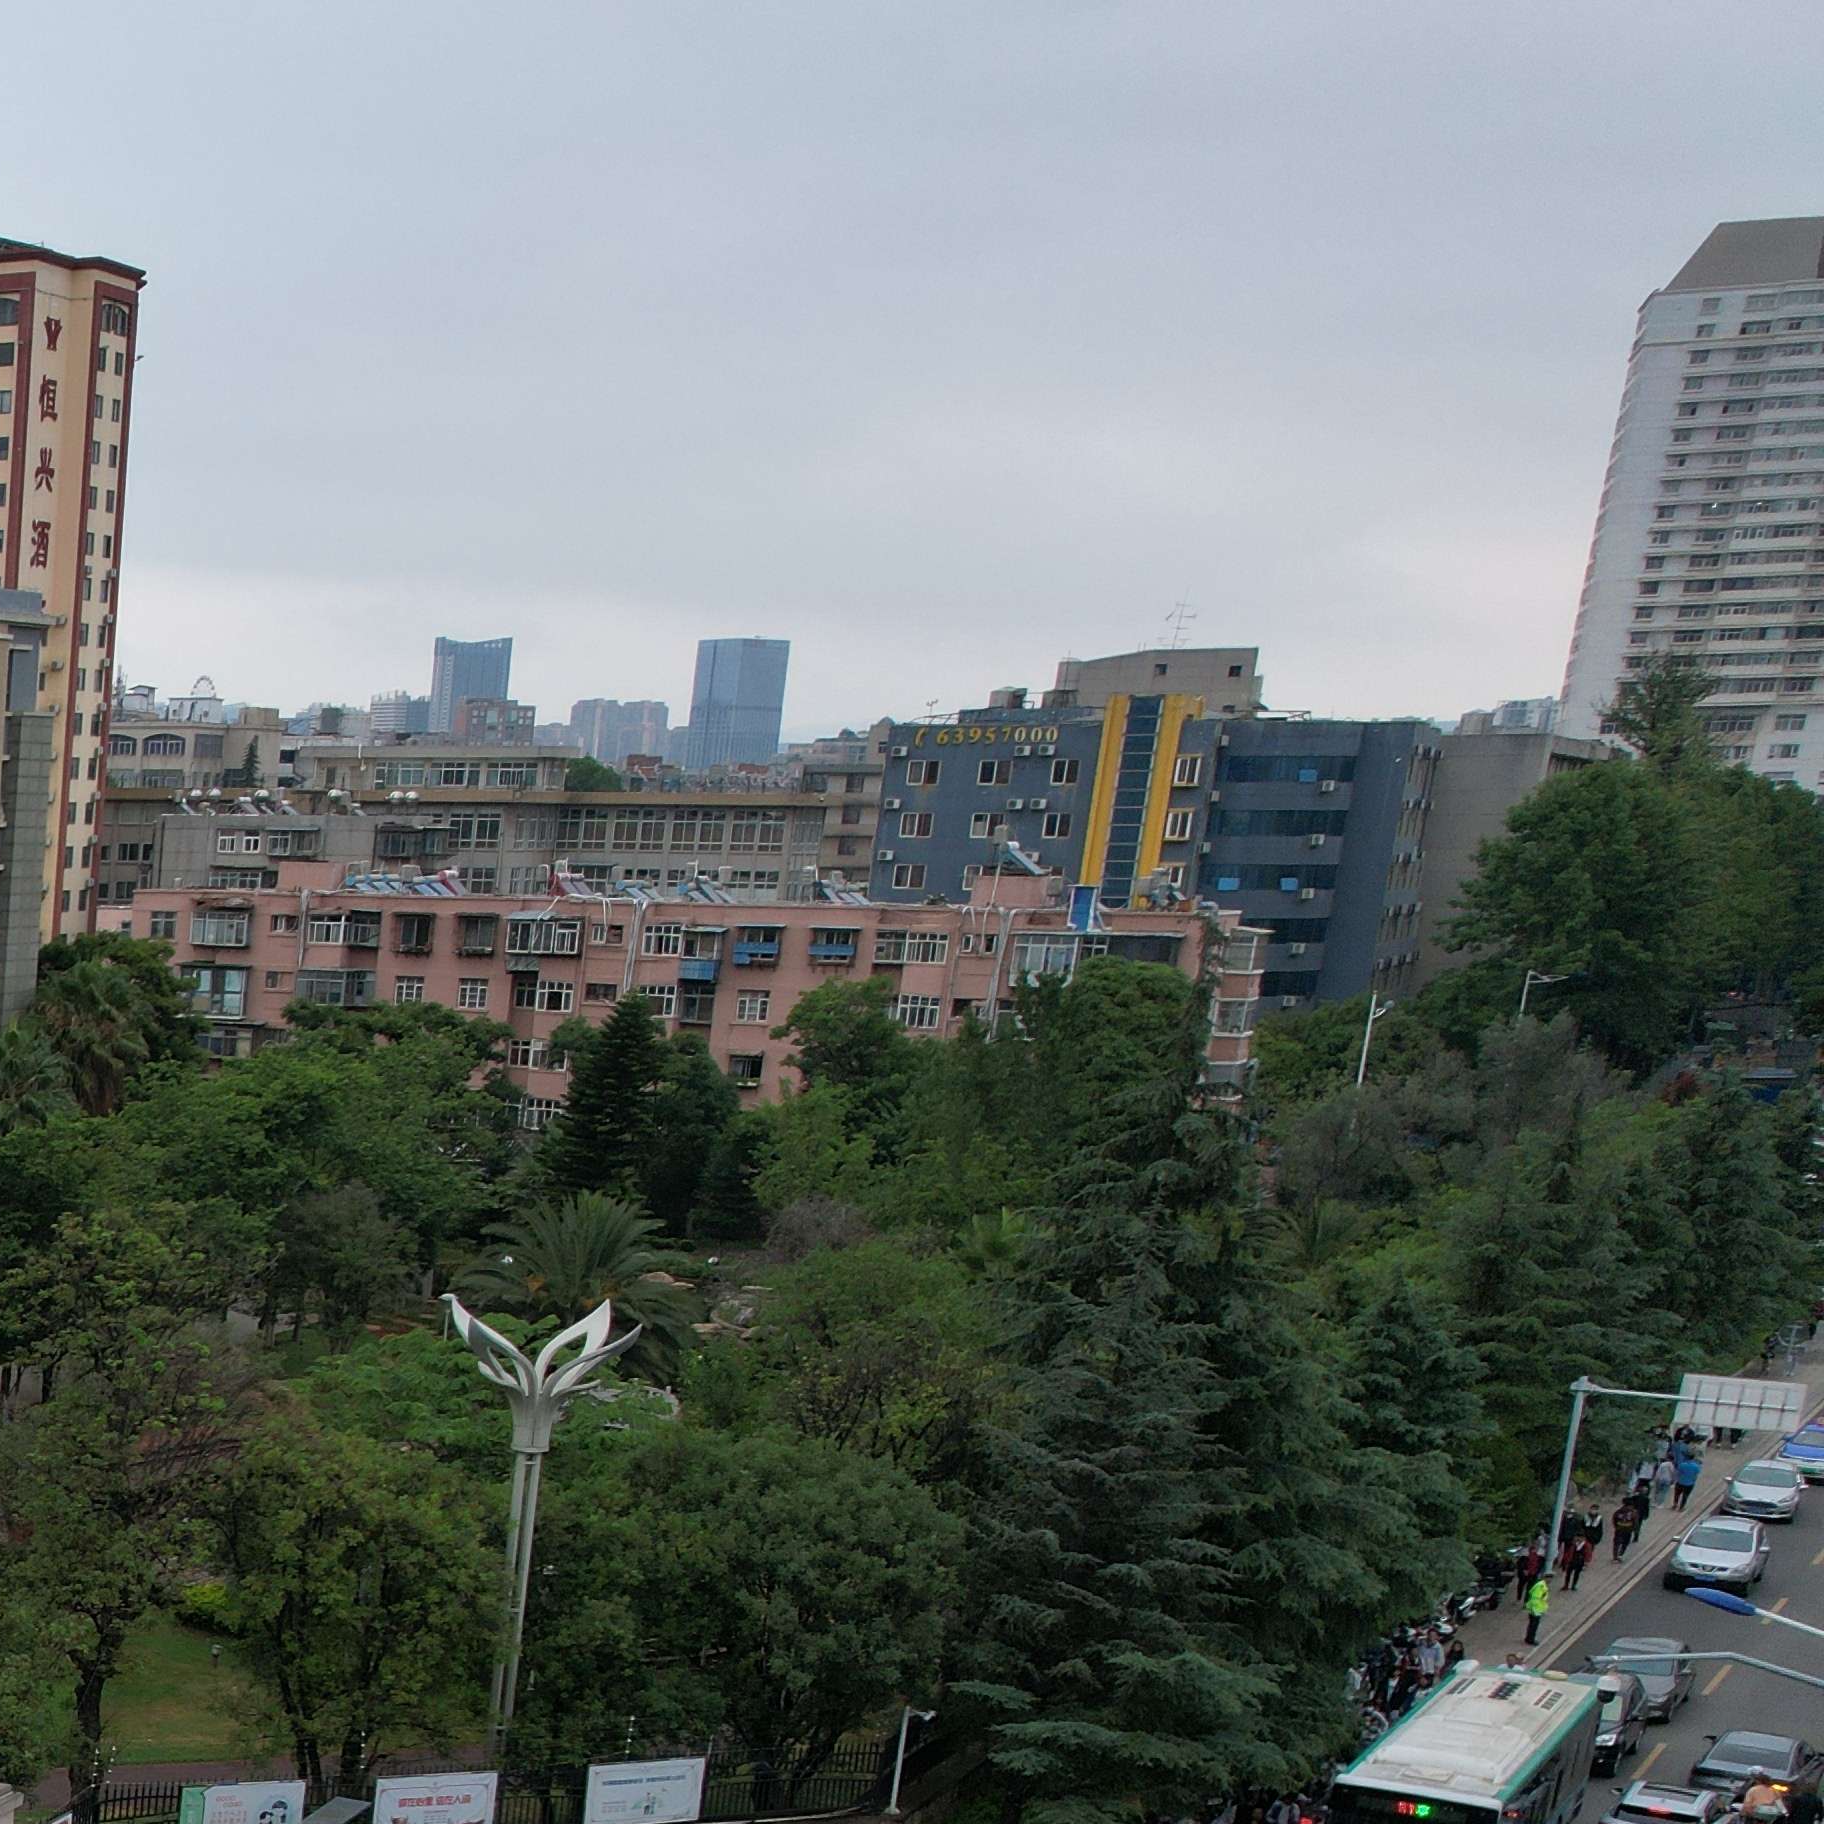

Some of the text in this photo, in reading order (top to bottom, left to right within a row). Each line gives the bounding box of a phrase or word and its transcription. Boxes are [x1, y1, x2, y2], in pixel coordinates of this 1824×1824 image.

[29, 375, 59, 570] 恒兴酒
[935, 726, 1059, 745] 63957000
